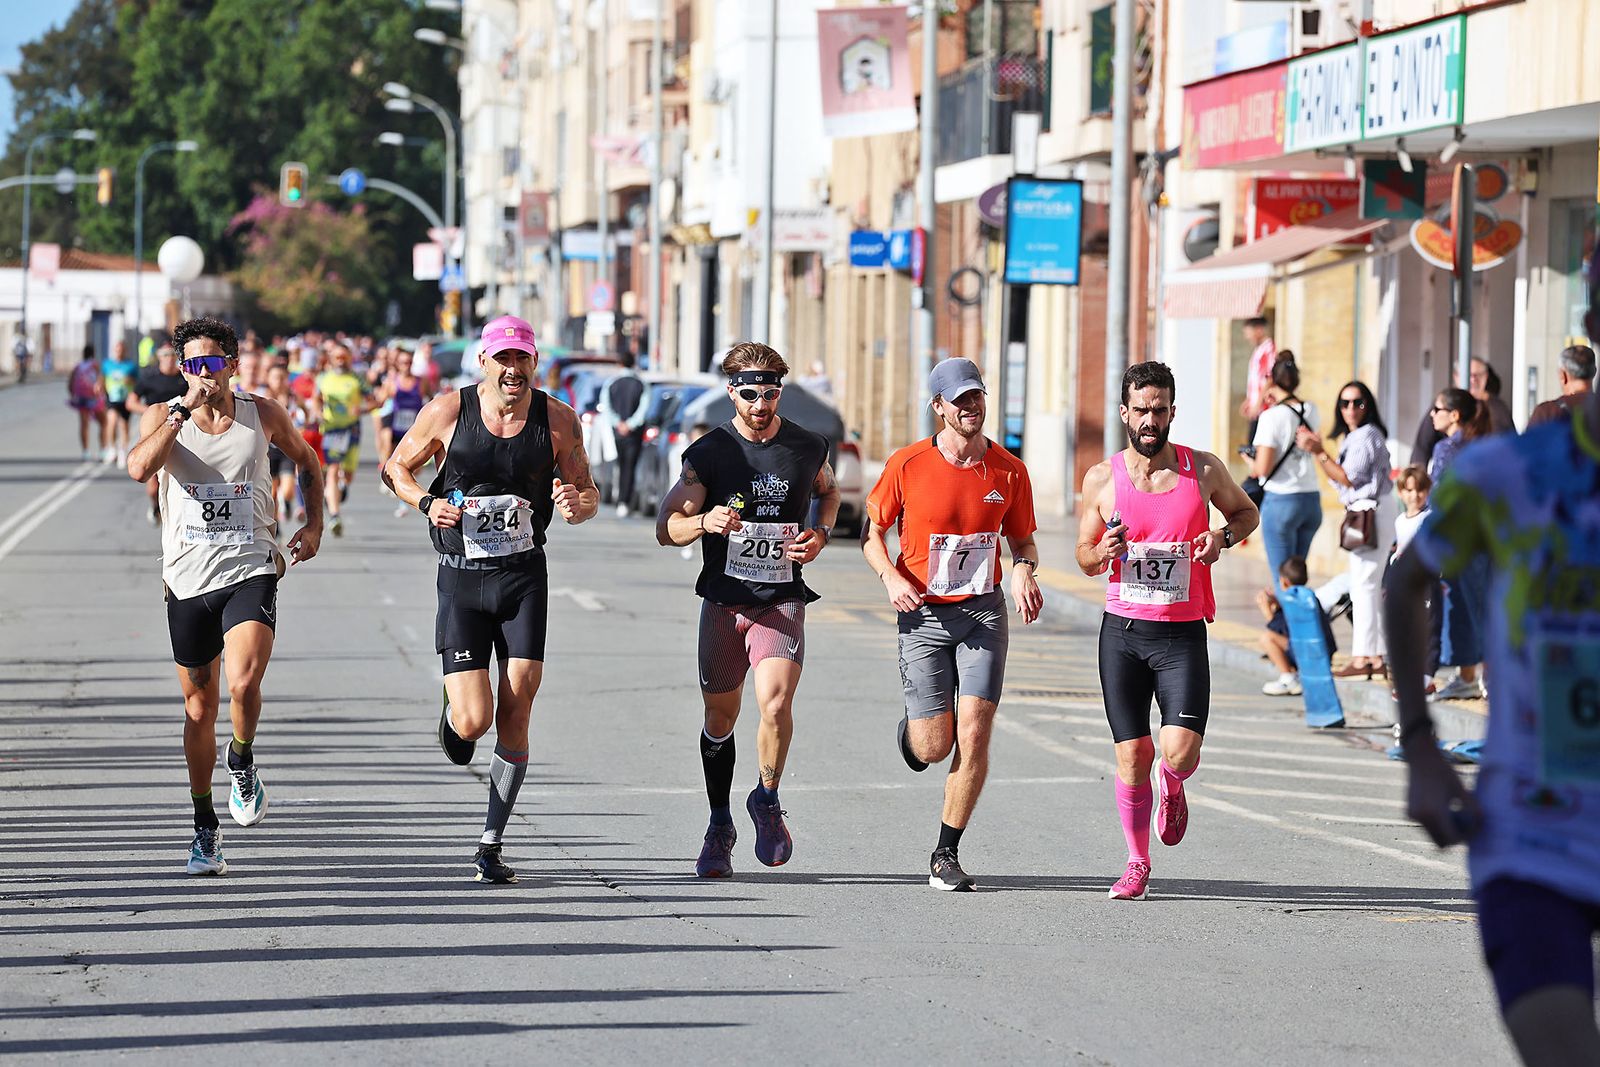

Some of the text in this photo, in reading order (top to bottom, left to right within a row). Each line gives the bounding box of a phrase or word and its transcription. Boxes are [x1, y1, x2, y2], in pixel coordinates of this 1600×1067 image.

[1368, 51, 1383, 129] EL
[1391, 33, 1443, 124] PUNTO
[234, 484, 248, 495] 2K
[202, 501, 232, 522] 84
[476, 510, 520, 534] 254
[782, 525, 795, 536] 2K
[934, 536, 949, 547] 2K
[980, 534, 993, 544] 2K
[740, 539, 784, 560] 205
[956, 551, 970, 571] 7
[1132, 560, 1177, 580] 137
